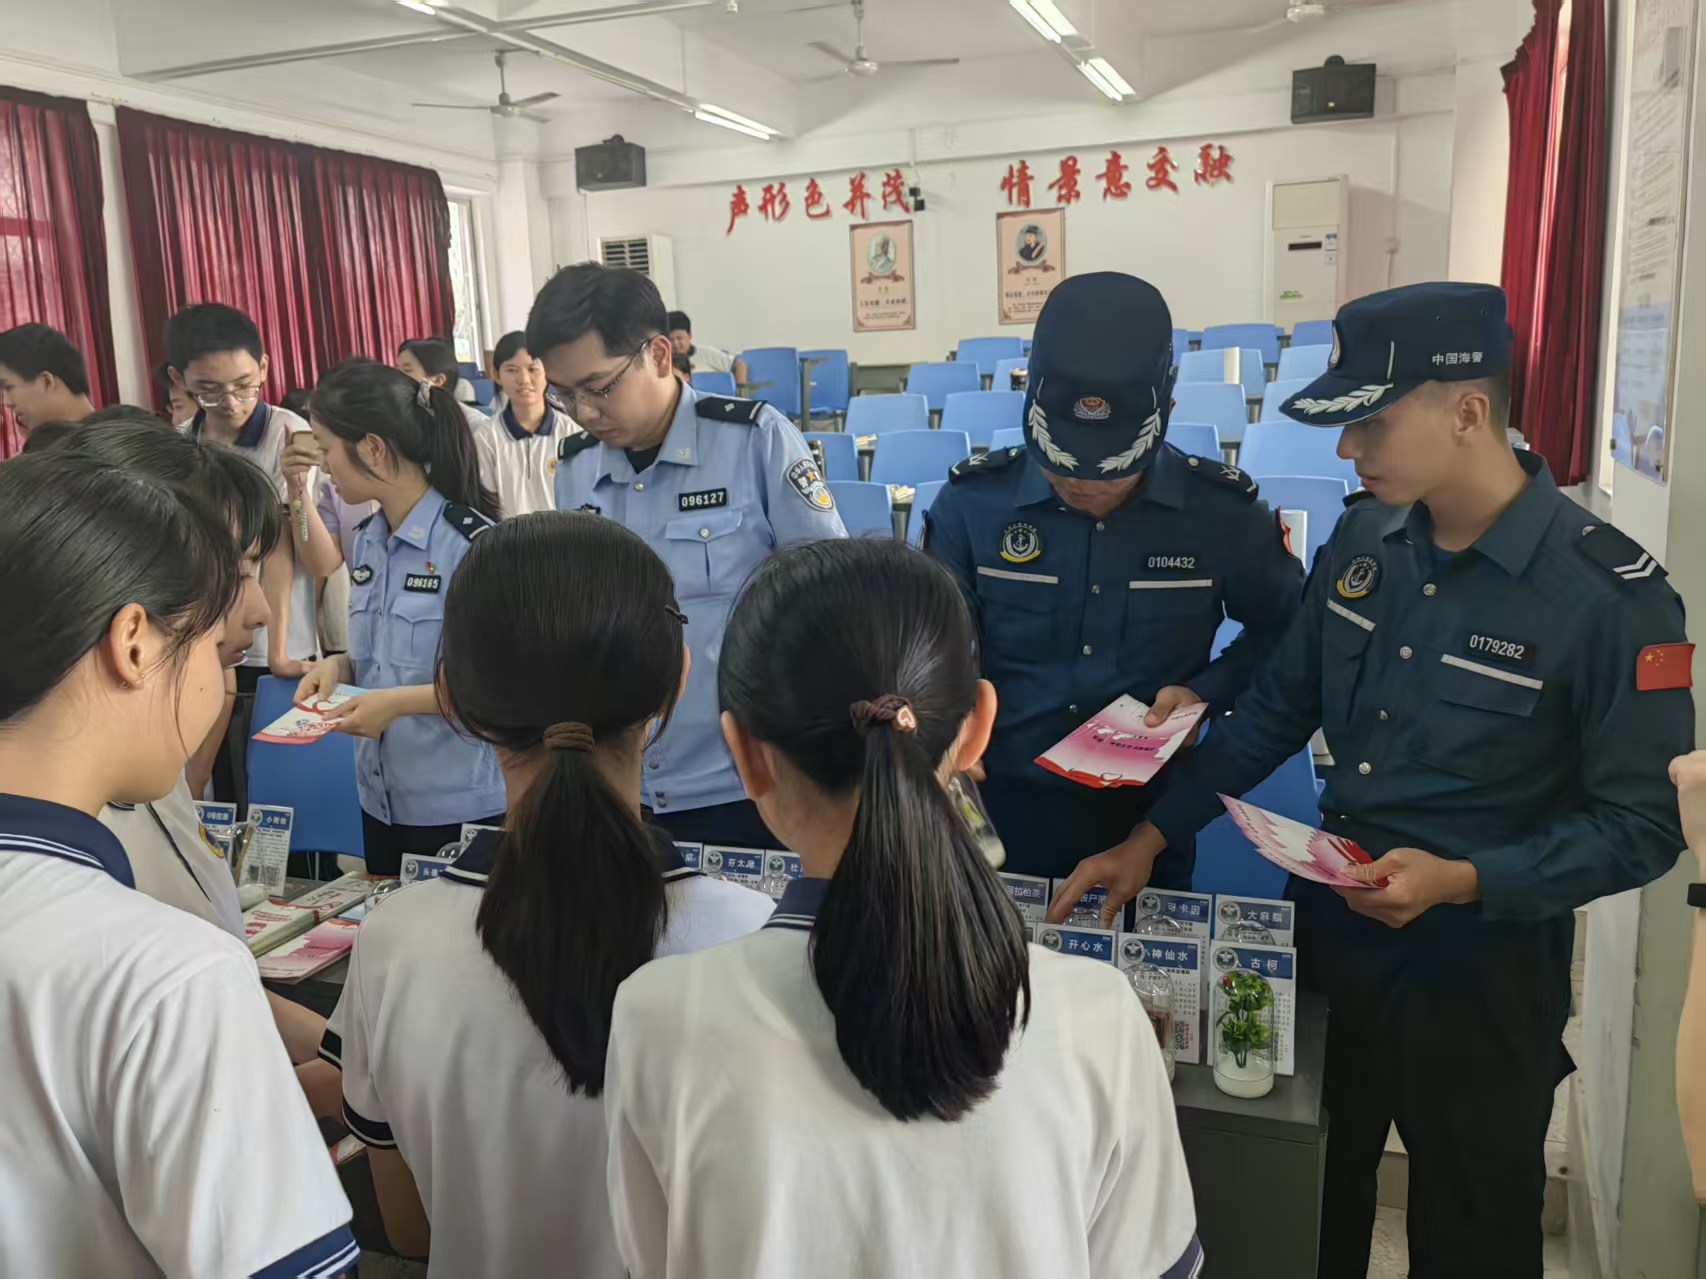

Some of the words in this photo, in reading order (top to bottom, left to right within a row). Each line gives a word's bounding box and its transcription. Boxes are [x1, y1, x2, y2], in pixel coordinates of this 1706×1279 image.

[726, 169, 910, 235] 声形色并茂
[1000, 143, 1235, 208] 情景意交融
[1431, 351, 1484, 366] 中国海警
[681, 491, 724, 507] 096127
[1147, 556, 1196, 569] 0104432
[406, 576, 439, 589] 096165
[1469, 634, 1525, 660] 0179282
[1068, 939, 1103, 953] 开心水
[1152, 947, 1188, 962] 神仙水
